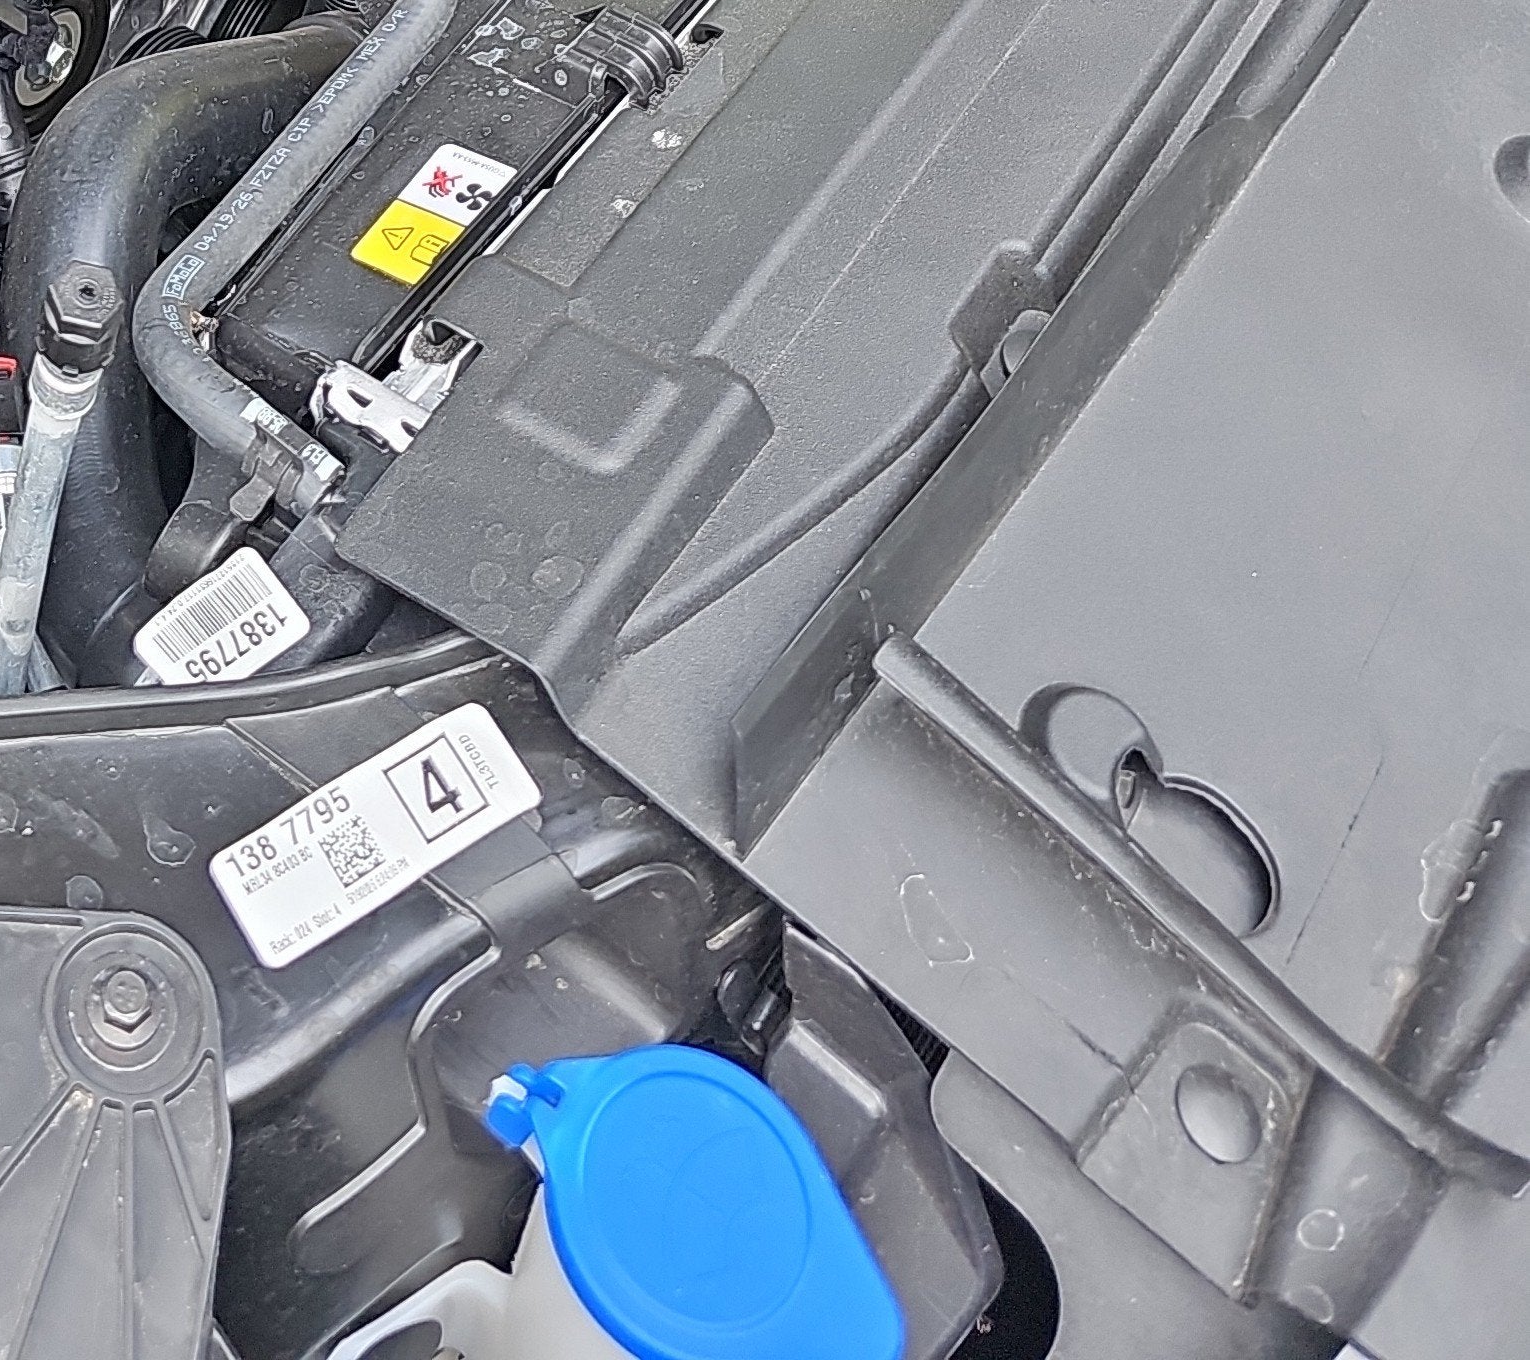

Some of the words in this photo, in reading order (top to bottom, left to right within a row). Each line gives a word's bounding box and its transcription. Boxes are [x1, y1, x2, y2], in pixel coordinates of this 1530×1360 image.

[164, 256, 203, 299] FoMoCo
[193, 191, 254, 252] 04/19/26
[183, 602, 290, 682] 1387795
[422, 755, 463, 814] 4
[225, 832, 278, 880] 138
[279, 786, 352, 848] 7795
[332, 903, 343, 916] 4
